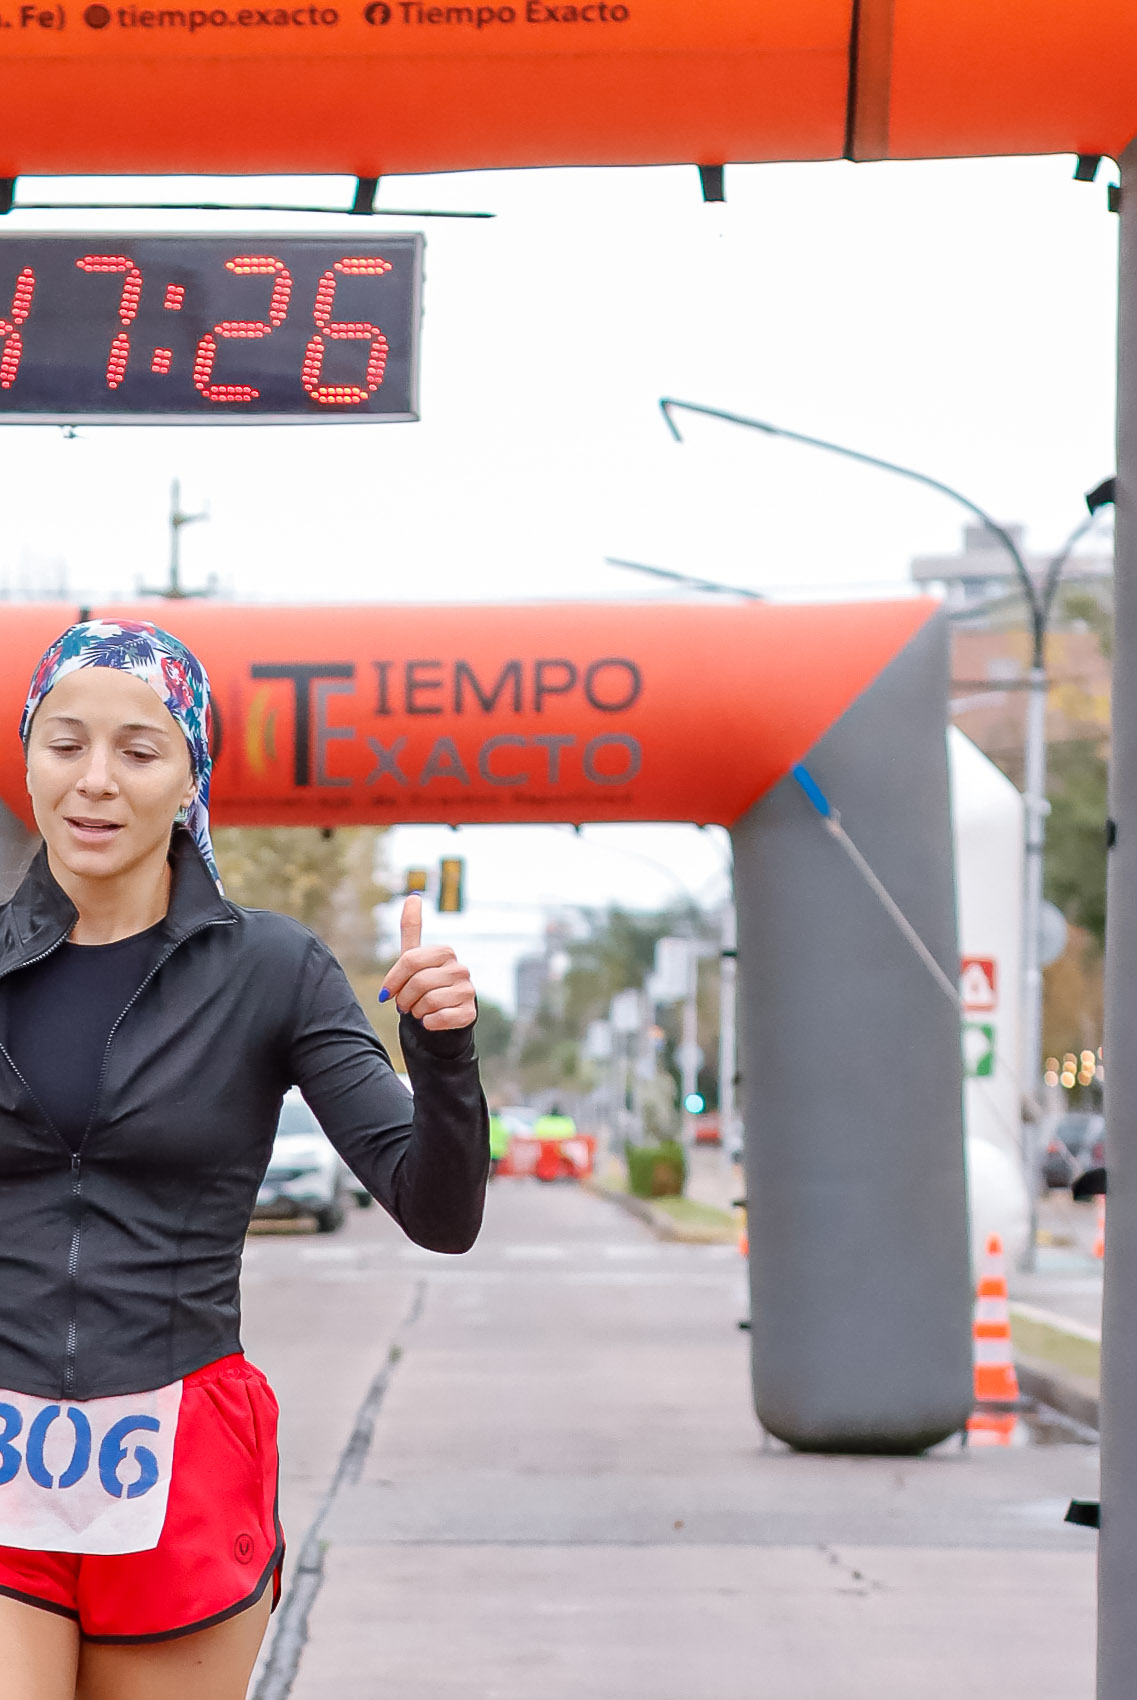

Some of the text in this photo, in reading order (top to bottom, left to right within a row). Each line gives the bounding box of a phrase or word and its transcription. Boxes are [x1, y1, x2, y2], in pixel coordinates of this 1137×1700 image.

[21, 4, 64, 30] Fe)
[117, 5, 339, 33] tiempo.exacto
[398, 1, 516, 29] Tiempo
[525, 0, 629, 23] Exacto
